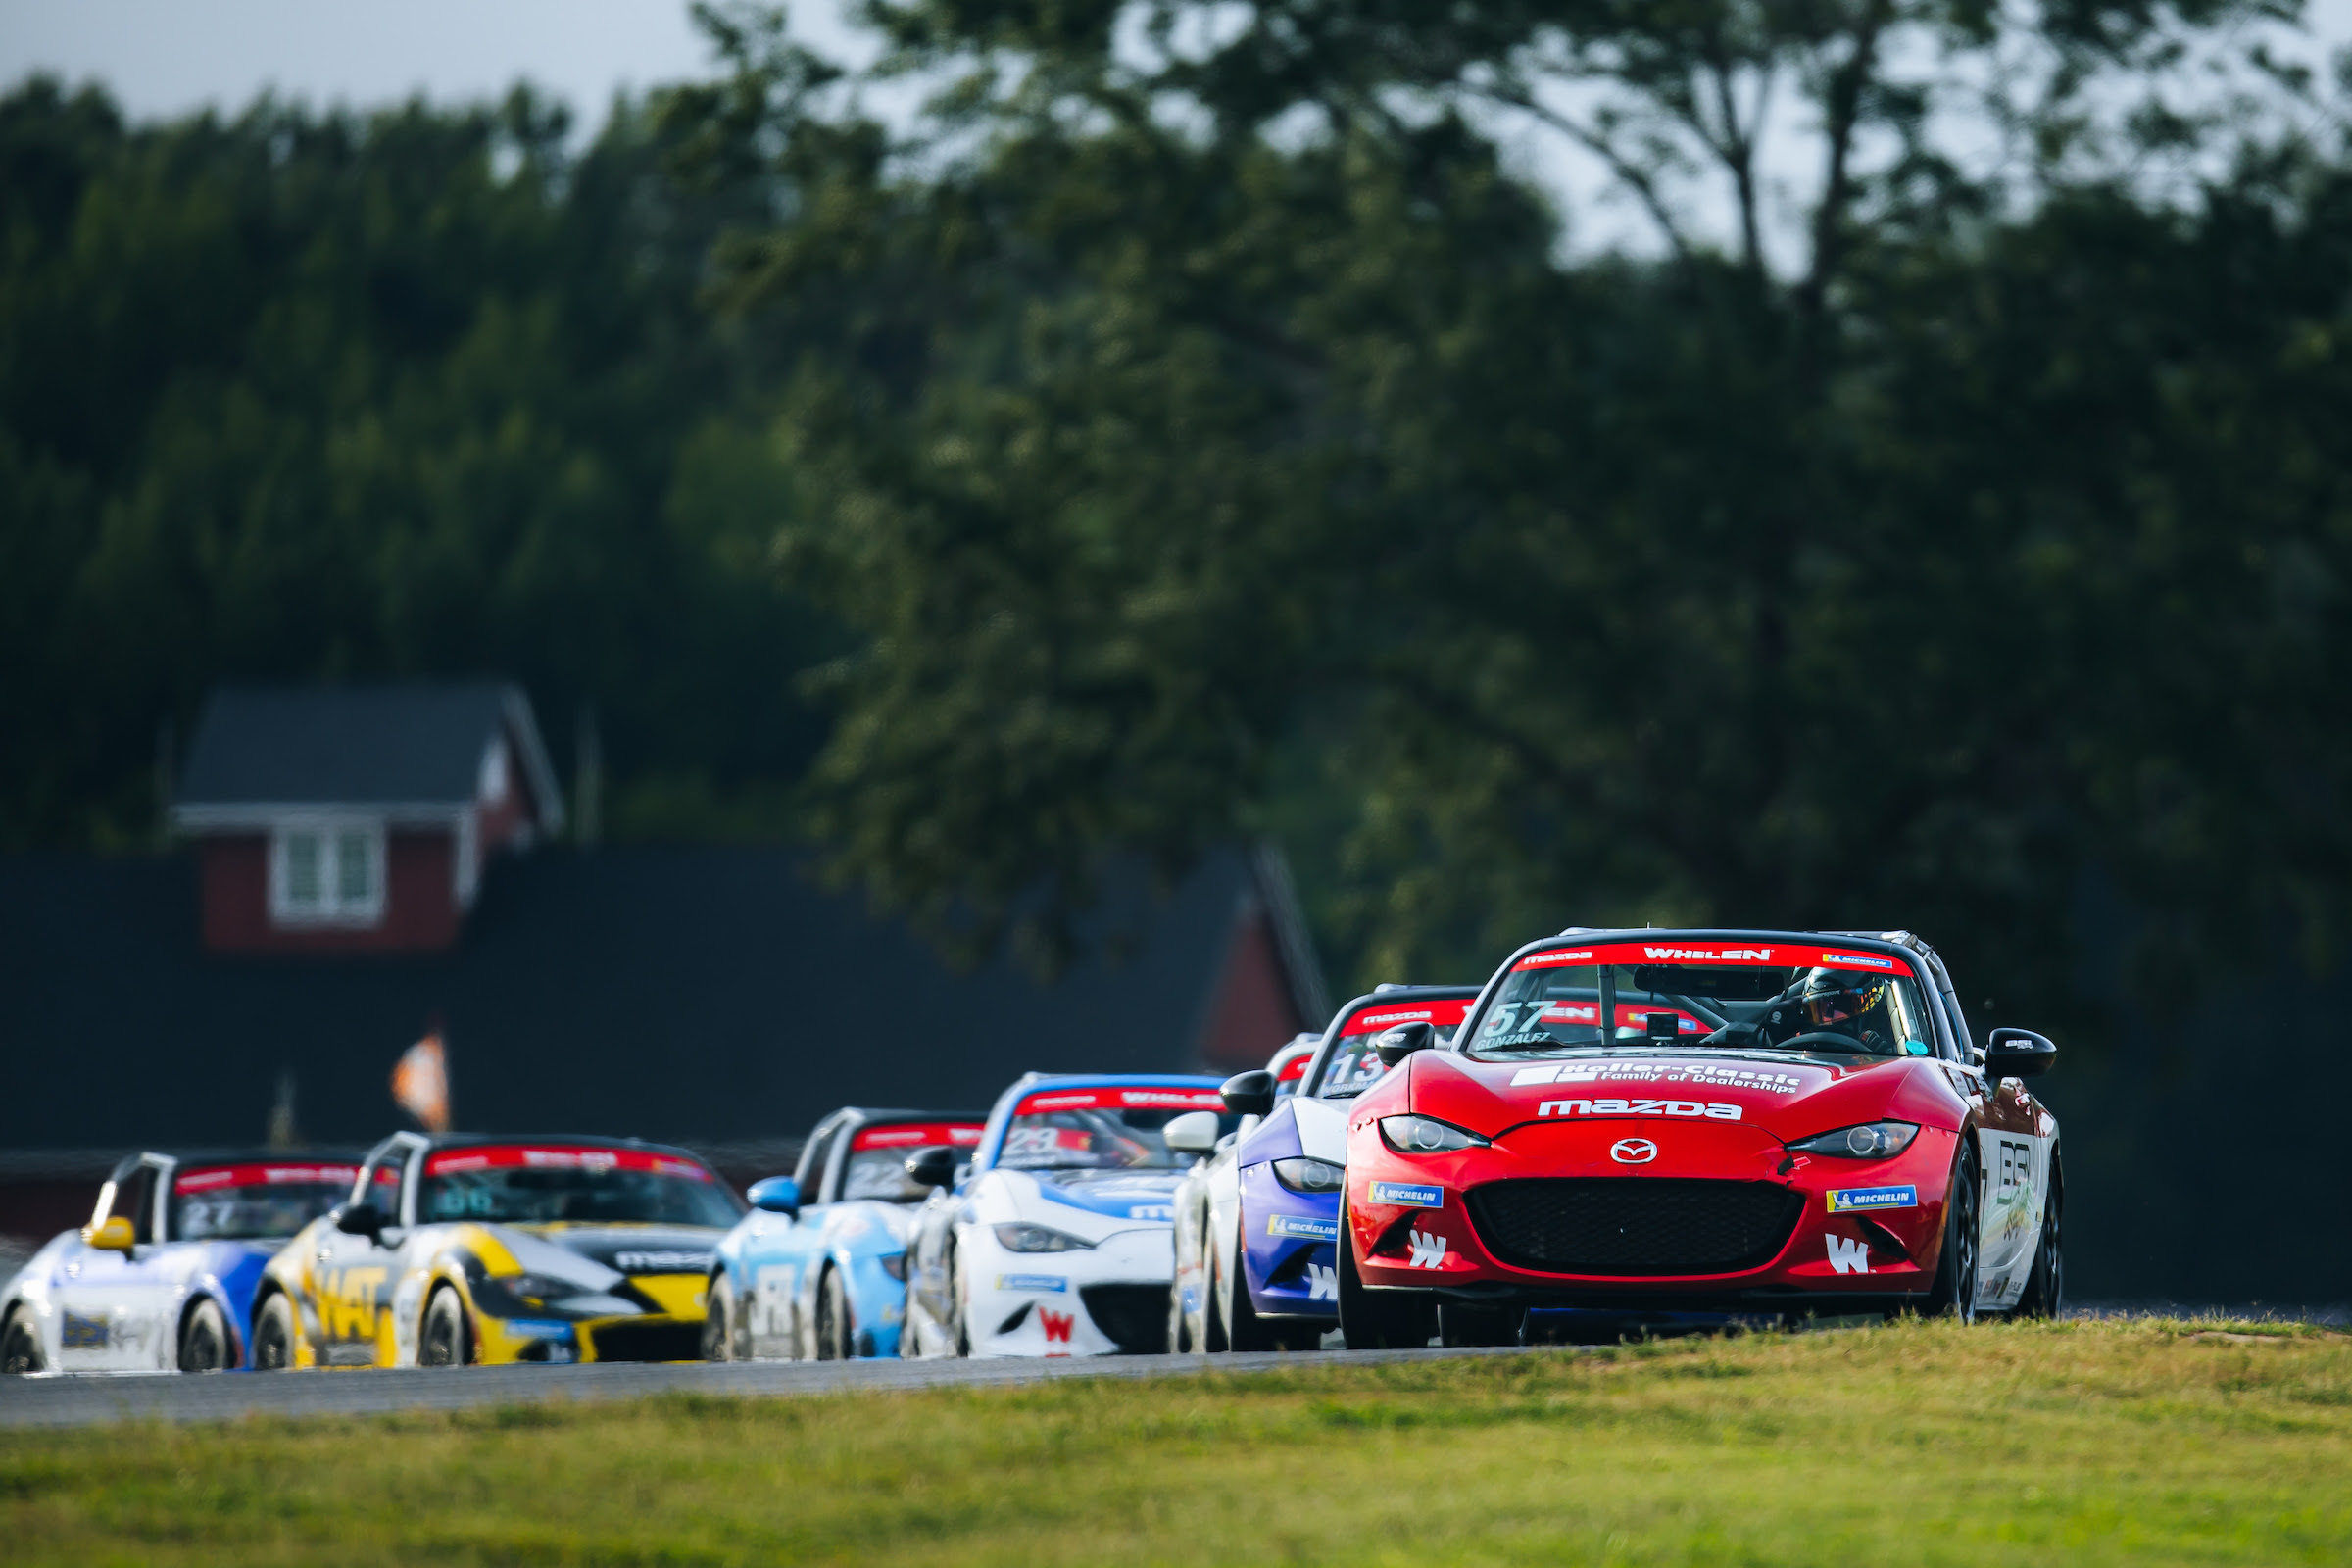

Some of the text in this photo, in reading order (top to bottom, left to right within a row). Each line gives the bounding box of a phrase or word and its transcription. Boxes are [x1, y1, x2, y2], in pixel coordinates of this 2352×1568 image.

[1643, 947, 1771, 961] WHELEN
[1483, 1001, 1557, 1038] 57
[1332, 1052, 1384, 1085] 13
[1563, 1062, 1801, 1087] Holler-Classic
[1600, 1070, 1797, 1094] Family of Dealerships
[1386, 1189, 1437, 1201] MICHELIN
[1853, 1192, 1910, 1204] MICHELIN
[1286, 1222, 1338, 1235] MICHELIN
